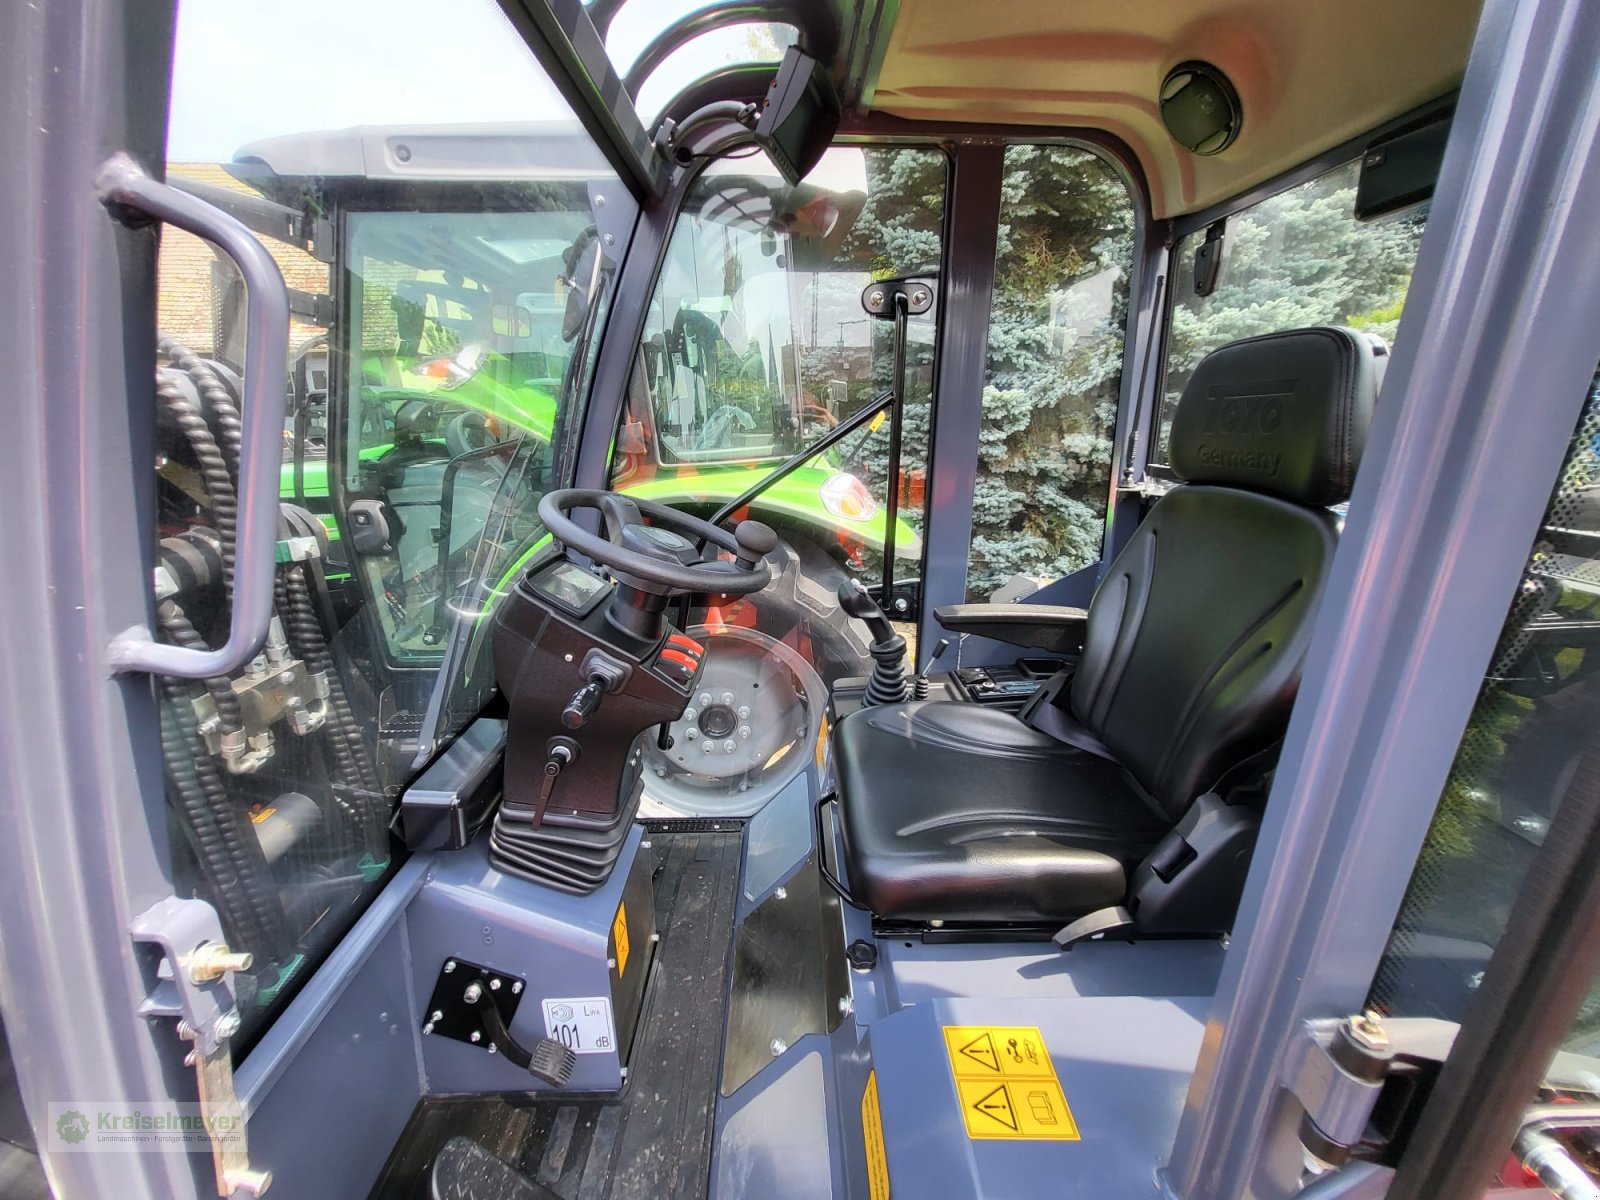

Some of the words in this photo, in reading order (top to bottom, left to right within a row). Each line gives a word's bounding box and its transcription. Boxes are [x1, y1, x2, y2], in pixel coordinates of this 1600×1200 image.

[1197, 444, 1282, 478] Germany
[553, 1024, 581, 1049] 101
[595, 1036, 610, 1048] dB
